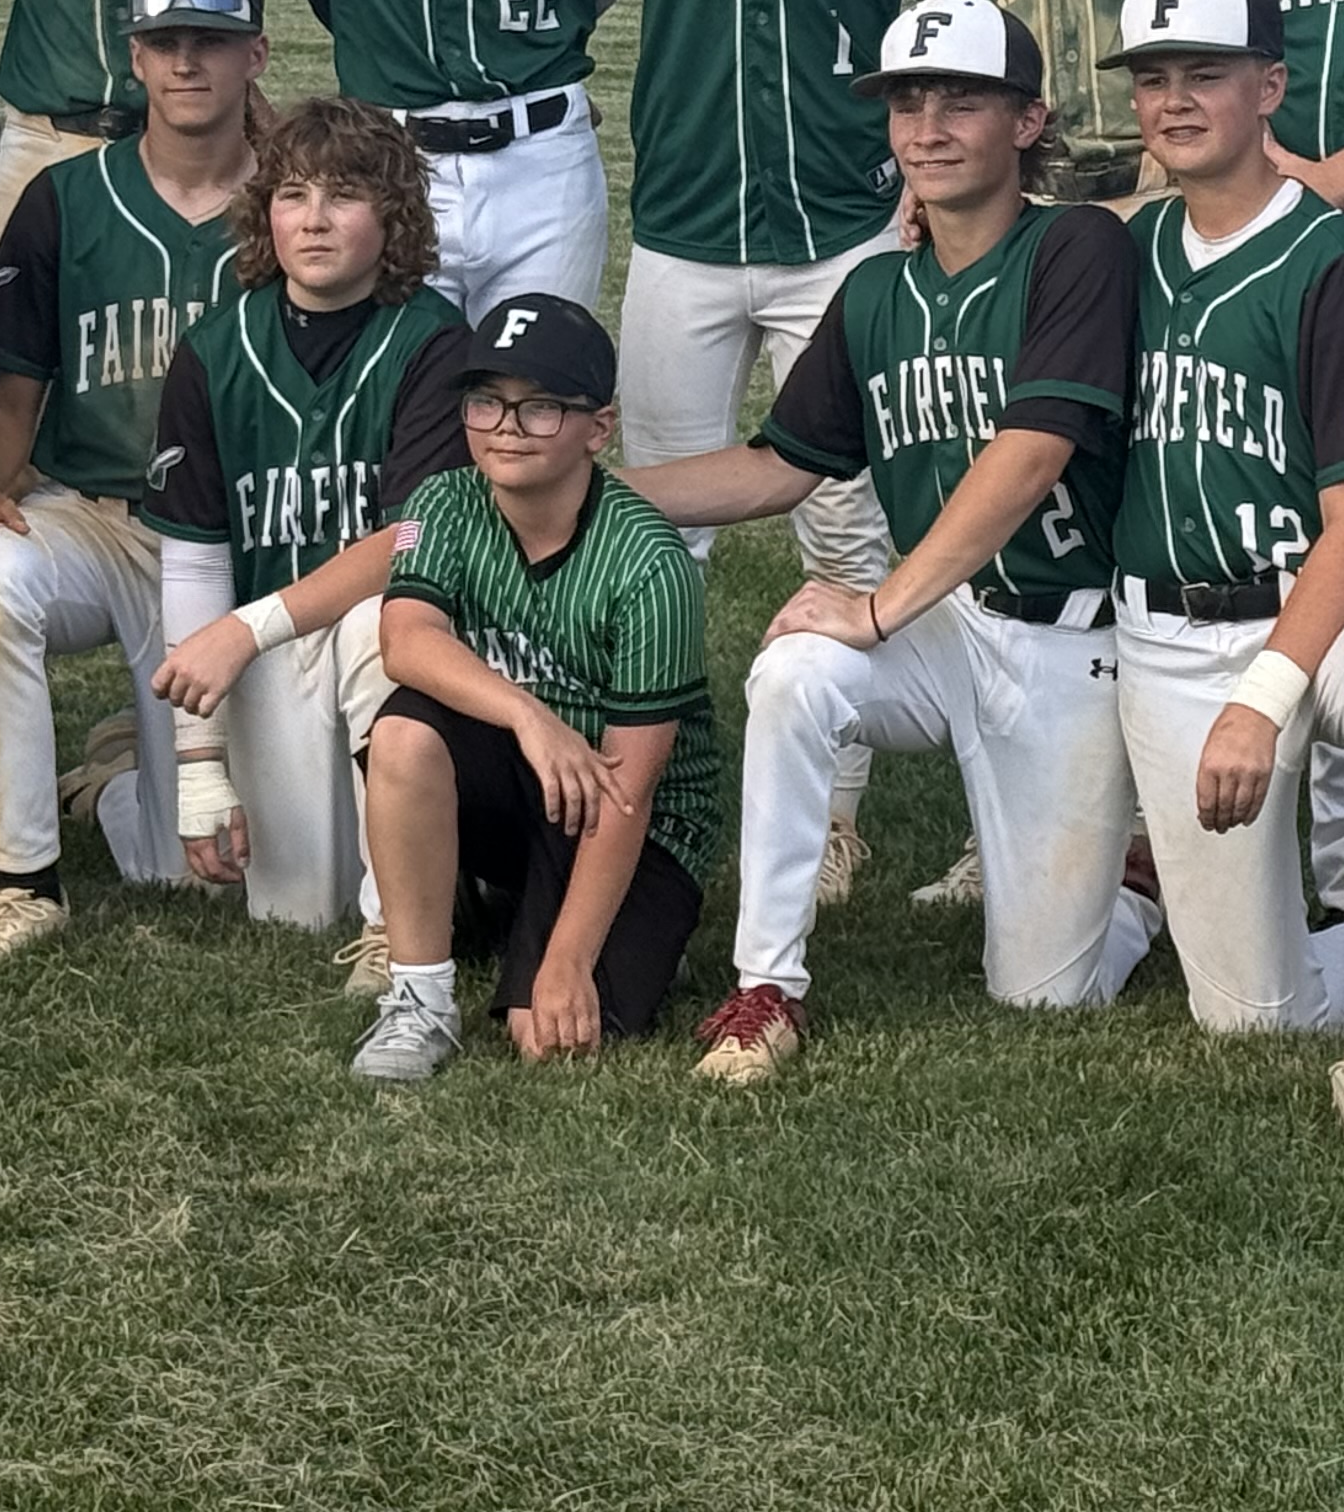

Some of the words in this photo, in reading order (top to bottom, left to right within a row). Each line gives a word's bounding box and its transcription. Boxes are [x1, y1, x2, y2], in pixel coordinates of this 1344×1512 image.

[910, 12, 952, 58] F
[494, 308, 539, 348] F
[1235, 503, 1309, 574] 12
